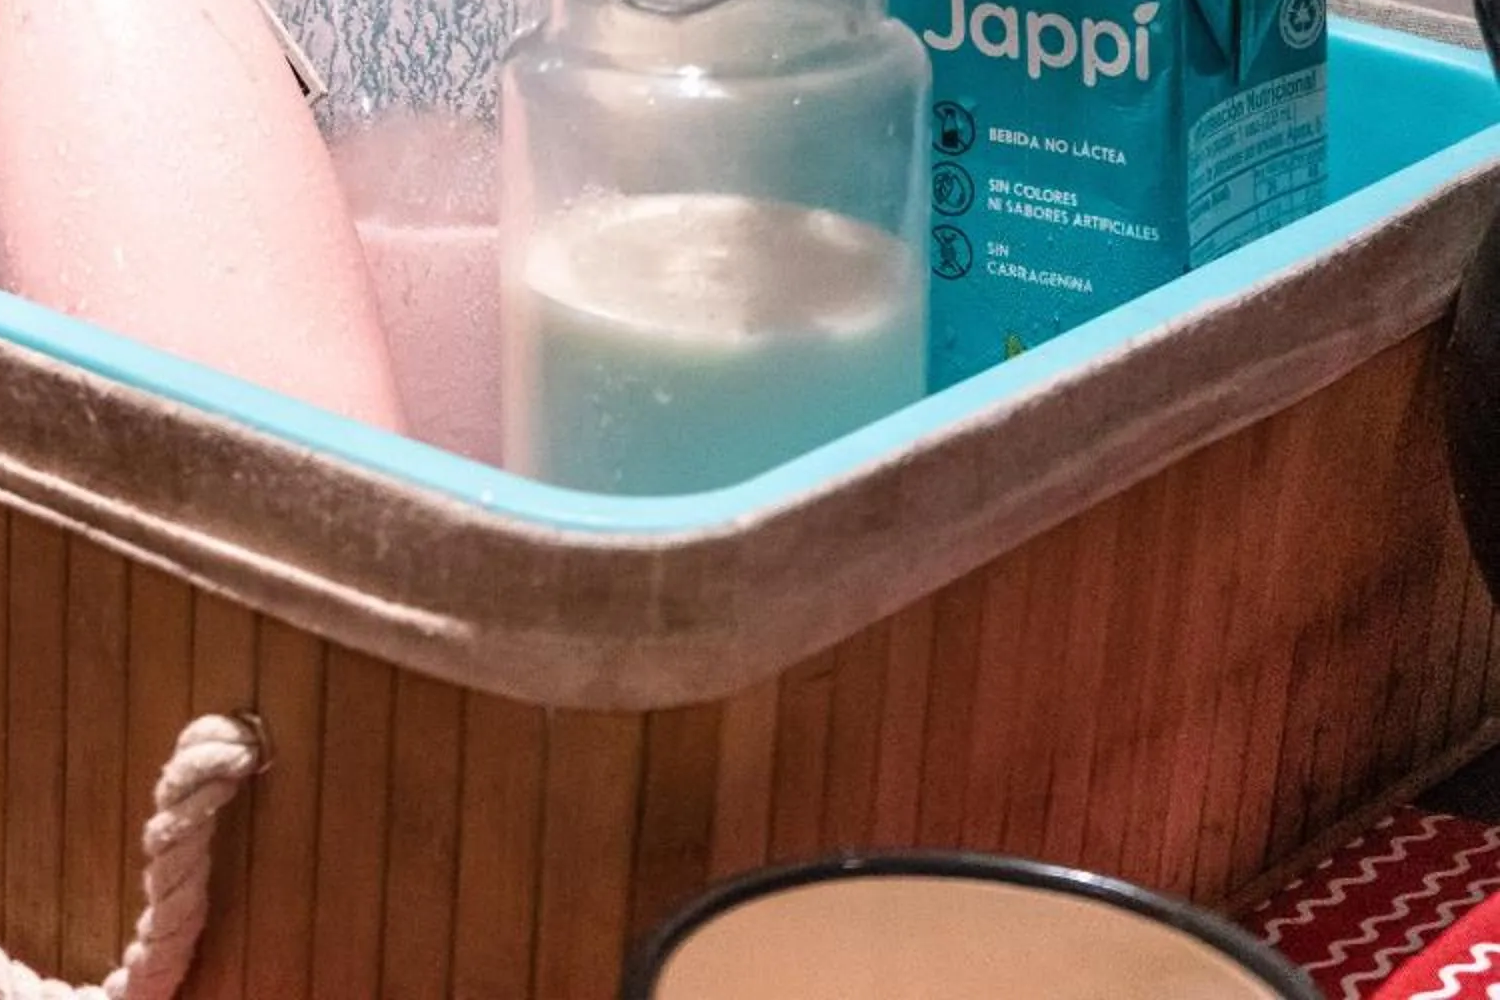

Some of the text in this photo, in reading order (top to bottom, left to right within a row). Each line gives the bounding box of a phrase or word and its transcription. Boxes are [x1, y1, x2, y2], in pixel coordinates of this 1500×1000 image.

[989, 127, 1126, 165] BEBIDA NO LÁCTEA
[988, 178, 1077, 207] SIN COLORES
[988, 197, 1160, 242] NI SABORES ARTIFICIALES
[987, 241, 1009, 257] SIN
[987, 260, 1093, 293] CARRAGENINA
